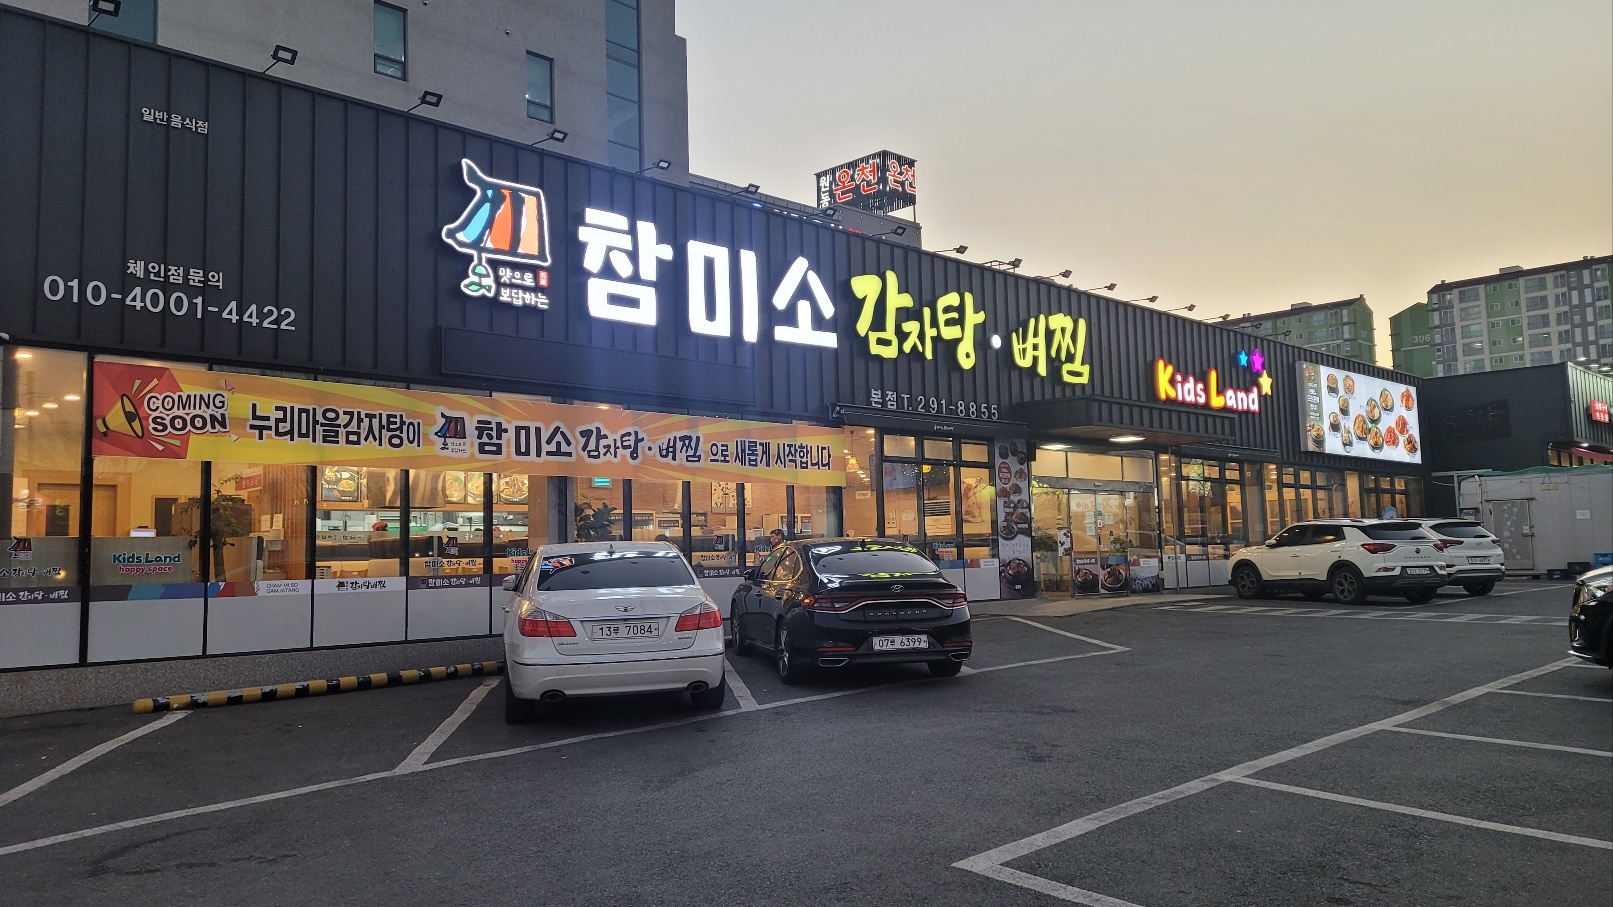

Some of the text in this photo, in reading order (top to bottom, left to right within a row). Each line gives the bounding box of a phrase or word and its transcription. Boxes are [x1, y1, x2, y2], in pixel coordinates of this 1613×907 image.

[833, 159, 878, 203] 온천
[886, 159, 917, 195] 온천
[499, 266, 535, 286] 맛으로
[578, 208, 838, 348] 참미소
[43, 275, 297, 331] 010-4001-4422
[499, 287, 549, 309] 보답하는
[1412, 333, 1432, 344] 306
[1156, 358, 1207, 405] Kids
[1208, 367, 1260, 413] Land
[147, 393, 226, 412] COMING
[151, 412, 228, 432] SOON
[249, 403, 421, 448] 누리마을감자탕이
[475, 419, 573, 458] 참미소
[709, 442, 730, 464] 으로
[733, 440, 771, 468] 새롭게
[774, 442, 832, 470] 시작합니다
[112, 553, 181, 564] Kids Land
[119, 565, 145, 574] happy
[625, 623, 653, 636] 7084
[900, 637, 922, 647] 6399
